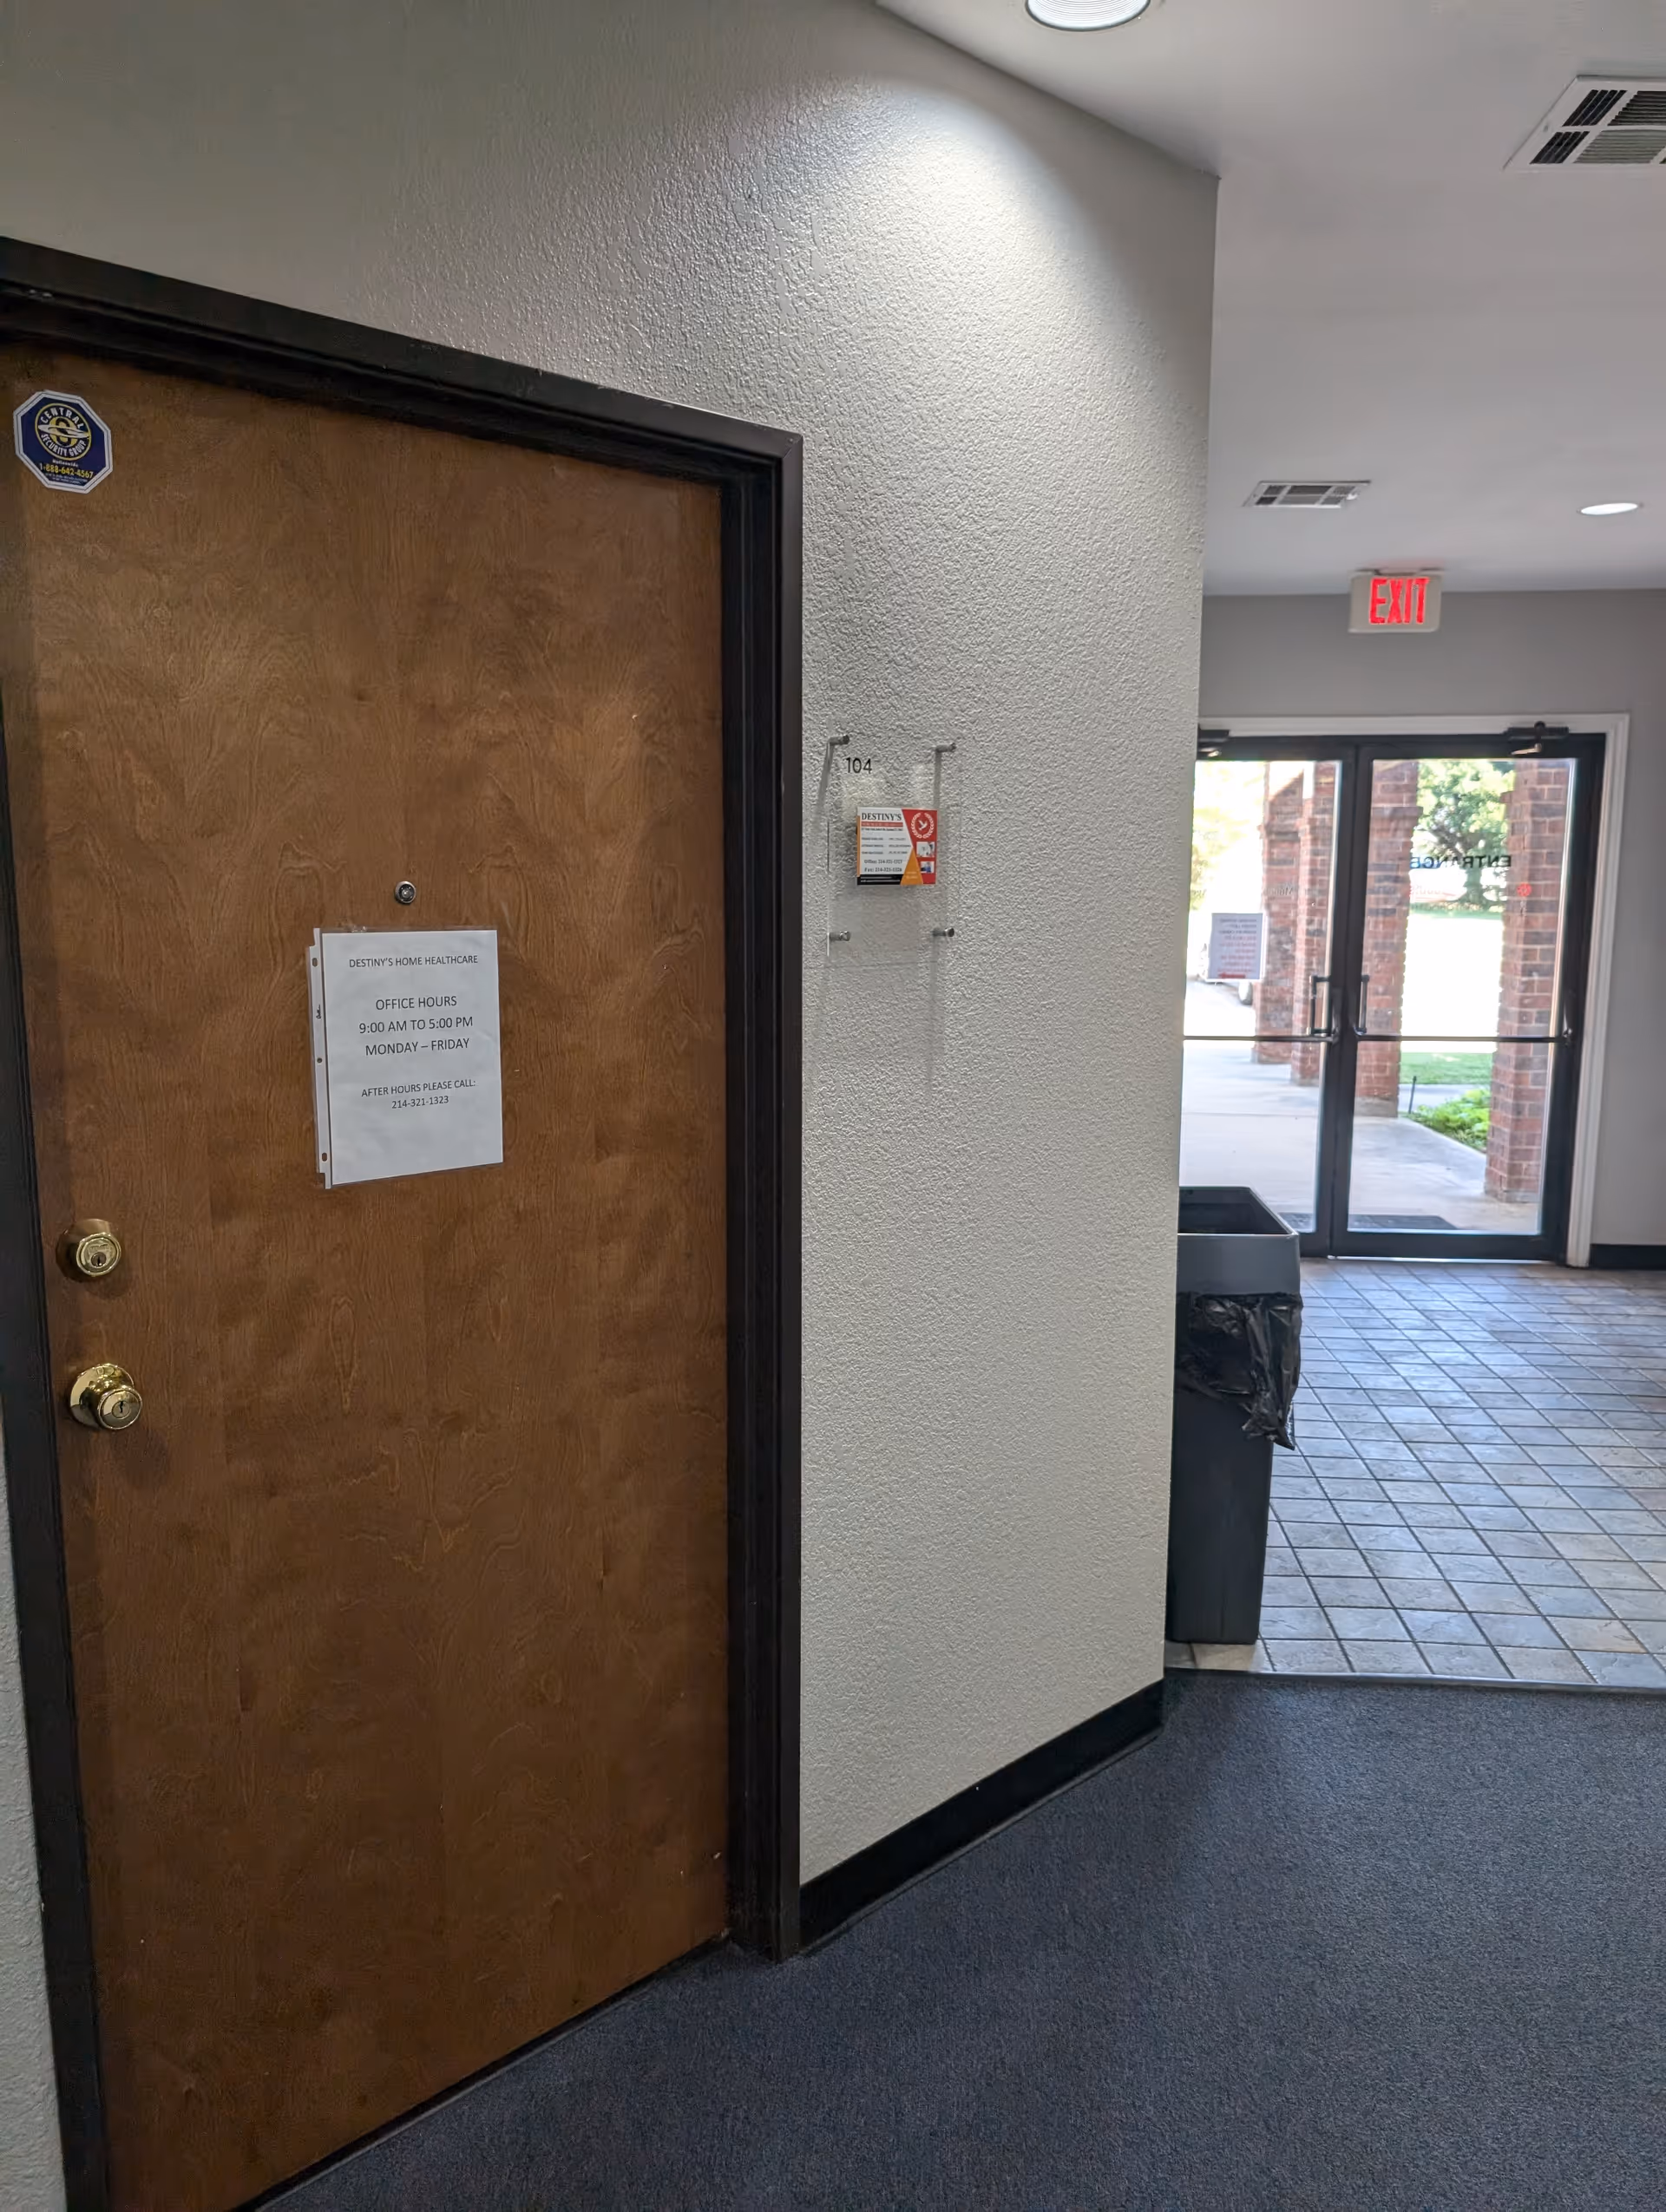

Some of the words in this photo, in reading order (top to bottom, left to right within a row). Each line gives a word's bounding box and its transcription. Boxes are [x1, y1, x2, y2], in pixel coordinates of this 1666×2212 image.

[40, 407, 85, 430] CENTRAL
[41, 434, 68, 456] SECURITY
[69, 439, 87, 457] GROUP
[38, 463, 94, 479] 1-888-642-4567
[1369, 577, 1430, 625] EXIT
[845, 756, 873, 774] 104
[861, 812, 902, 821] DESTINY'S
[349, 958, 394, 968] DESTINY'S
[395, 956, 423, 966] HOME
[424, 954, 478, 966] HEALTHCARE
[376, 998, 415, 1011] OFFICE
[418, 996, 457, 1008] HOURS
[359, 1020, 385, 1034] 9:00
[388, 1020, 408, 1032] AM
[410, 1018, 426, 1031] TO
[429, 1018, 453, 1030] 5:00
[456, 1016, 474, 1028] PM
[365, 1041, 418, 1057] MONDAY
[430, 1037, 470, 1051] FRIDAY
[361, 1086, 389, 1097] AFTER
[390, 1083, 421, 1095] HOURS
[423, 1081, 452, 1093] PLEASE
[455, 1079, 476, 1090] CALL:
[391, 1096, 449, 1109] 214-321-1323
